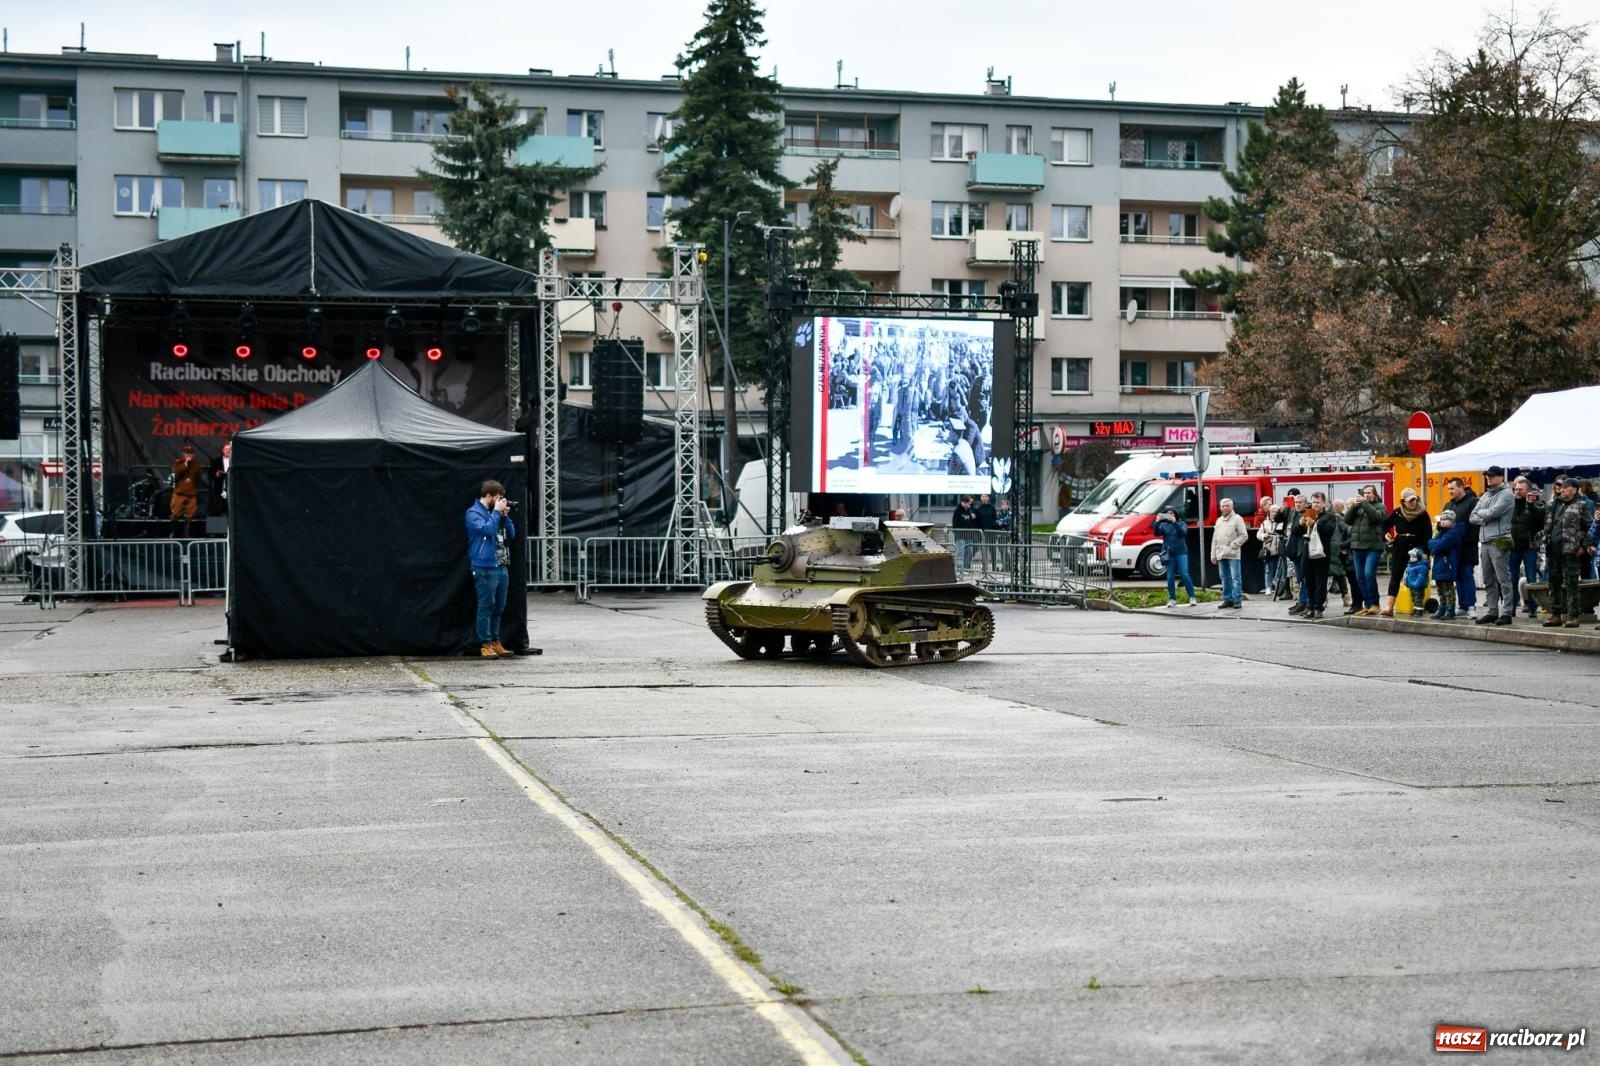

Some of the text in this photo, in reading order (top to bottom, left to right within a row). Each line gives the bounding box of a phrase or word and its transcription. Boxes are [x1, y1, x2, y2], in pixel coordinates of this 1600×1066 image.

[150, 362, 342, 385] Raciborskie Obchody
[128, 389, 246, 412] Narodowego
[152, 413, 240, 437] Żołnierzy
[1168, 428, 1198, 441] MAX
